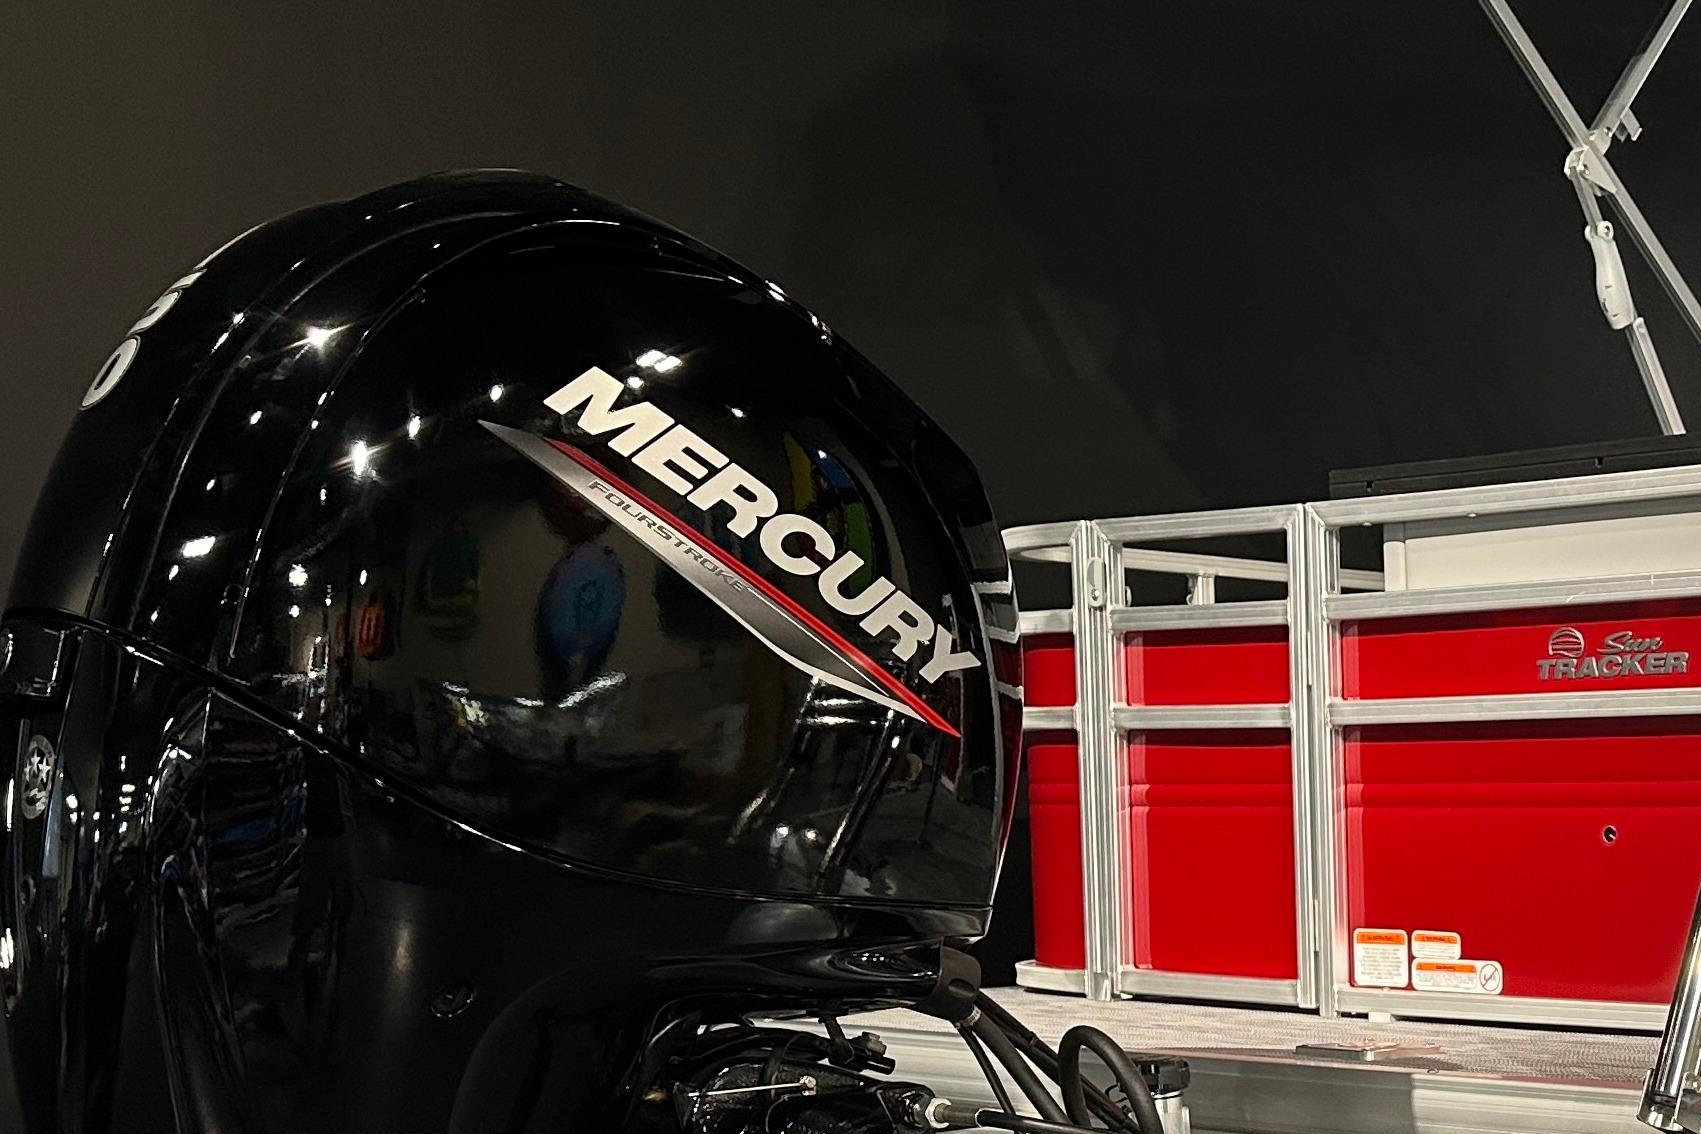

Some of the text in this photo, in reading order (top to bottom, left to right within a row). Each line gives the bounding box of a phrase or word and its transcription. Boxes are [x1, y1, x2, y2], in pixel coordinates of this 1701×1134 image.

[543, 366, 981, 684] MERCURY
[588, 481, 743, 592] FOURSTROKE
[1536, 652, 1689, 680] TRACKER
[1596, 630, 1664, 654] Sun
